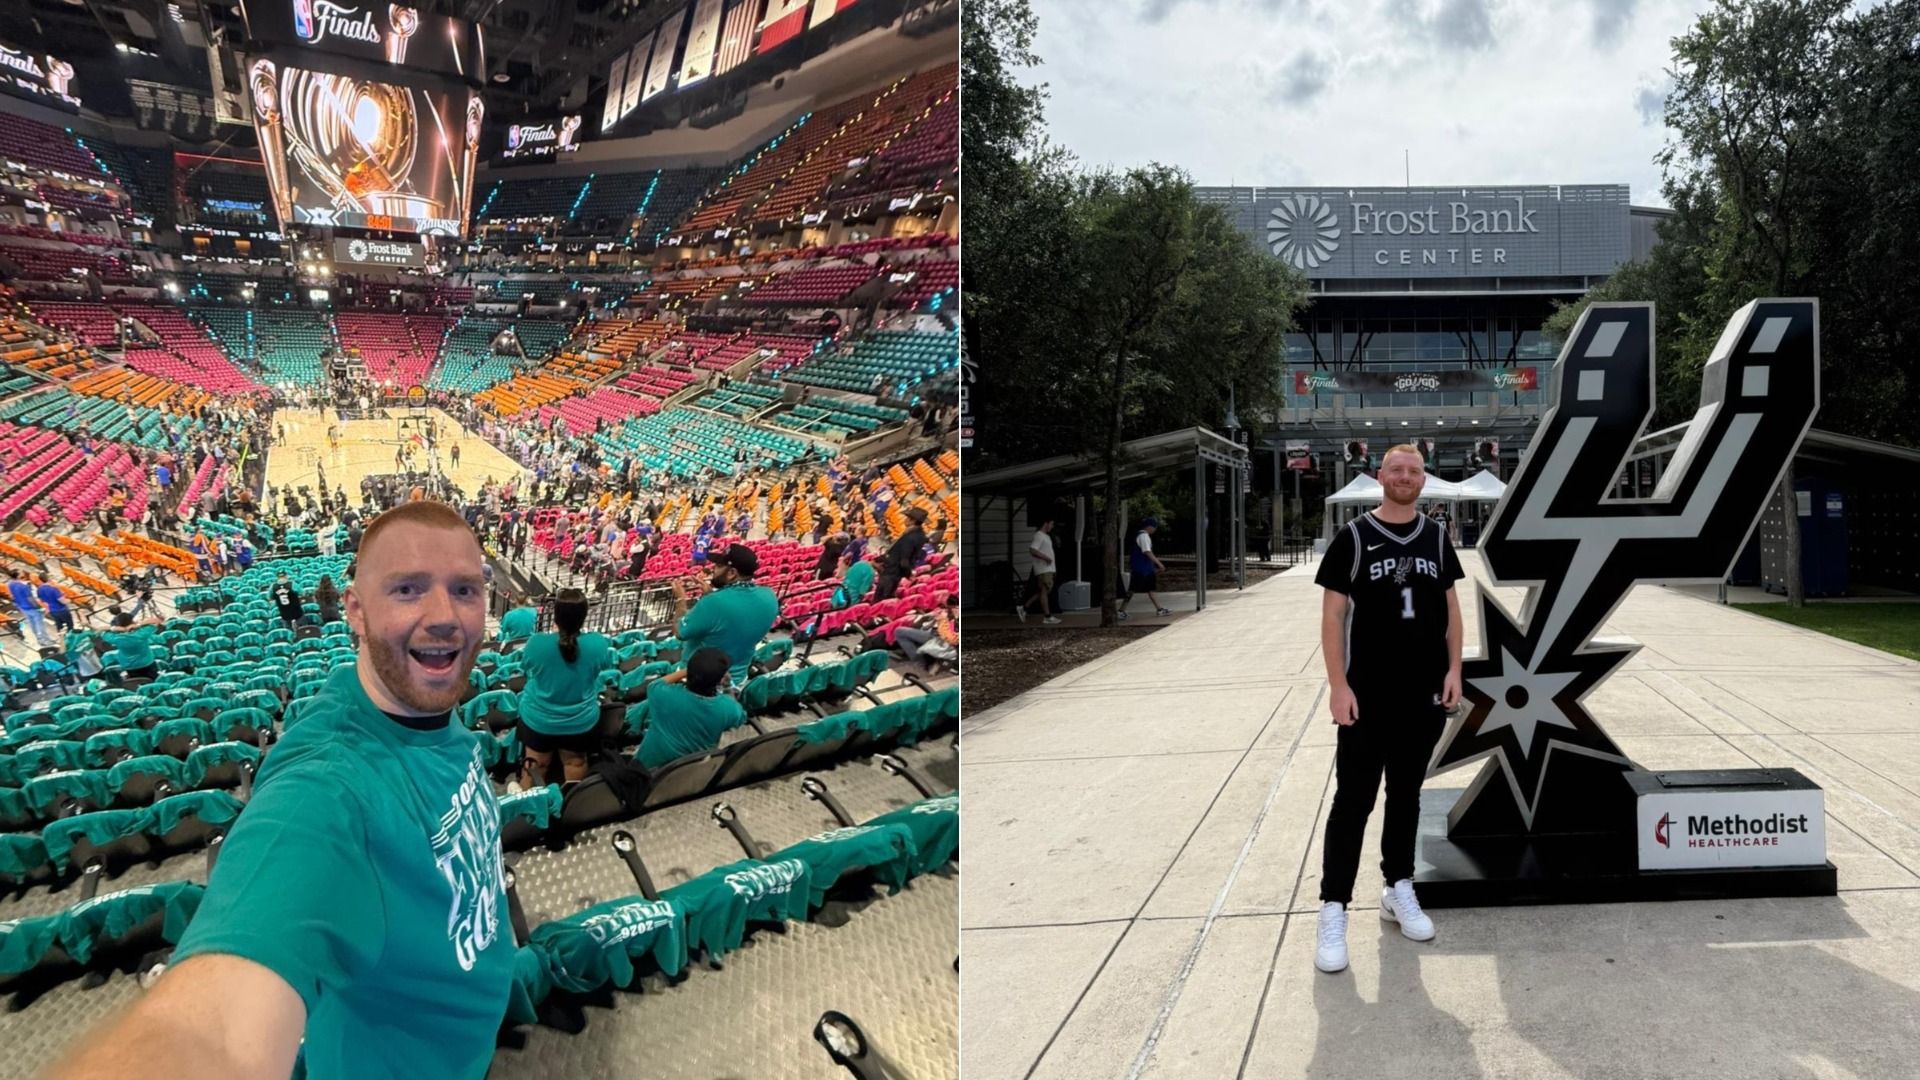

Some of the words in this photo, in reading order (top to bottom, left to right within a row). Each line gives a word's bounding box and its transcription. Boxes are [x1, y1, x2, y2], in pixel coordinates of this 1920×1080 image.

[308, 0, 381, 44] Finals
[0, 45, 45, 78] inals
[515, 124, 557, 149] Finals
[1351, 202, 1440, 235] Frost
[1448, 196, 1538, 235] Bank
[368, 242, 390, 254] Frost
[391, 244, 413, 256] Bank
[1375, 248, 1507, 266] CENTER
[374, 255, 406, 263] CENTER
[1309, 376, 1339, 389] Finals
[1399, 378, 1412, 389] GO
[1421, 378, 1435, 389] GO
[1499, 371, 1530, 387] Finals
[1401, 587, 1415, 619] 1
[1687, 813, 1808, 836] Methodist
[1688, 837, 1779, 848] HEALTHCARE
[621, 920, 654, 939] 2026
